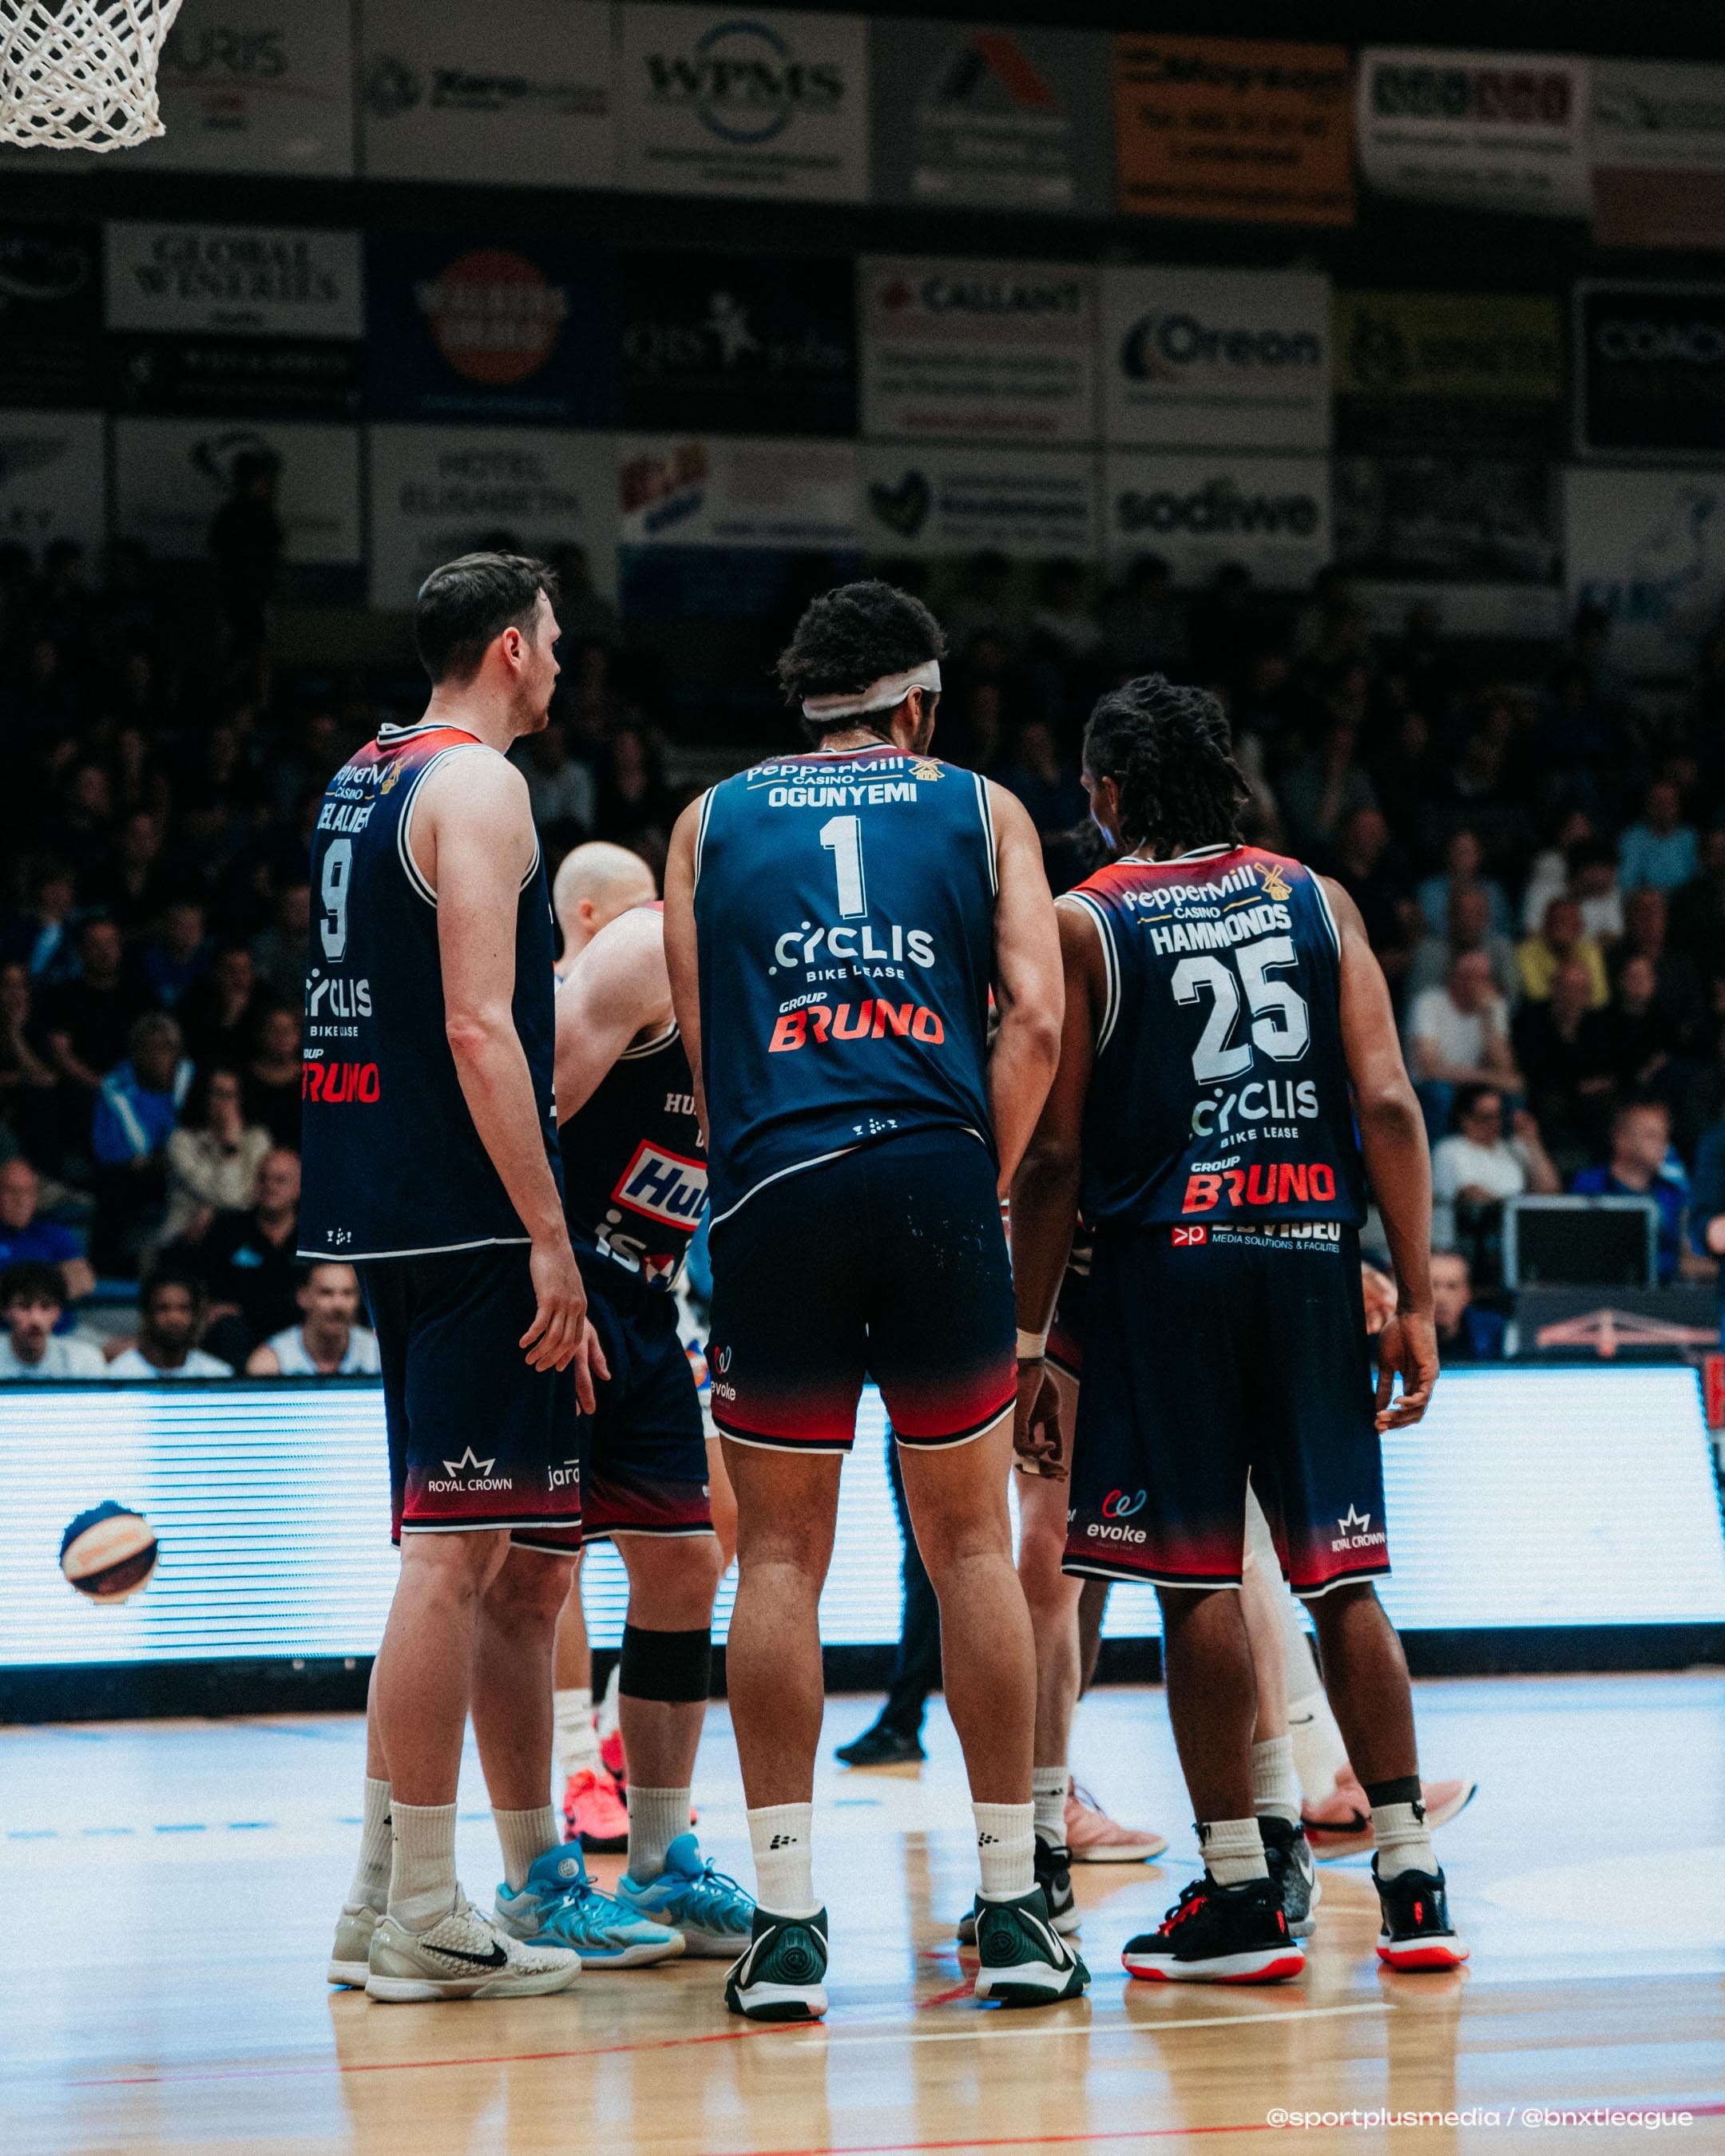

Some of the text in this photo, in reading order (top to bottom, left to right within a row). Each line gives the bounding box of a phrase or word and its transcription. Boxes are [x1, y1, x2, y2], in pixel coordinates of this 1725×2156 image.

[645, 53, 845, 101] WPMS
[747, 756, 904, 783] PepperMill
[792, 775, 855, 785] CASINO
[768, 783, 918, 807] OGUNYEMI
[819, 815, 867, 920] 1
[1122, 865, 1258, 911] PepperMill
[320, 838, 353, 962] 9
[1173, 906, 1221, 919] CASINO
[1150, 903, 1293, 955] HAMMONDS
[774, 921, 936, 969] CYCLIS
[806, 965, 906, 983] BIKE LEASE
[779, 992, 828, 1014] GROUP
[1171, 935, 1311, 1085] 25
[310, 1025, 339, 1037] BIKE
[768, 998, 946, 1053] BRUNO
[1191, 1080, 1319, 1137] CYCLIS
[1220, 1127, 1299, 1149] BIKE LEASE
[1191, 1155, 1241, 1173] GROUP
[1181, 1163, 1336, 1215] BRUNO
[1212, 1234, 1243, 1244] MEDIA
[1244, 1236, 1293, 1250] SOLUTIONS
[1296, 1240, 1303, 1250] &
[710, 1381, 736, 1401] evoke
[428, 1478, 513, 1492] ROYAL CROWN
[1086, 1523, 1147, 1544] evoke
[1352, 1532, 1386, 1548] CROWN
